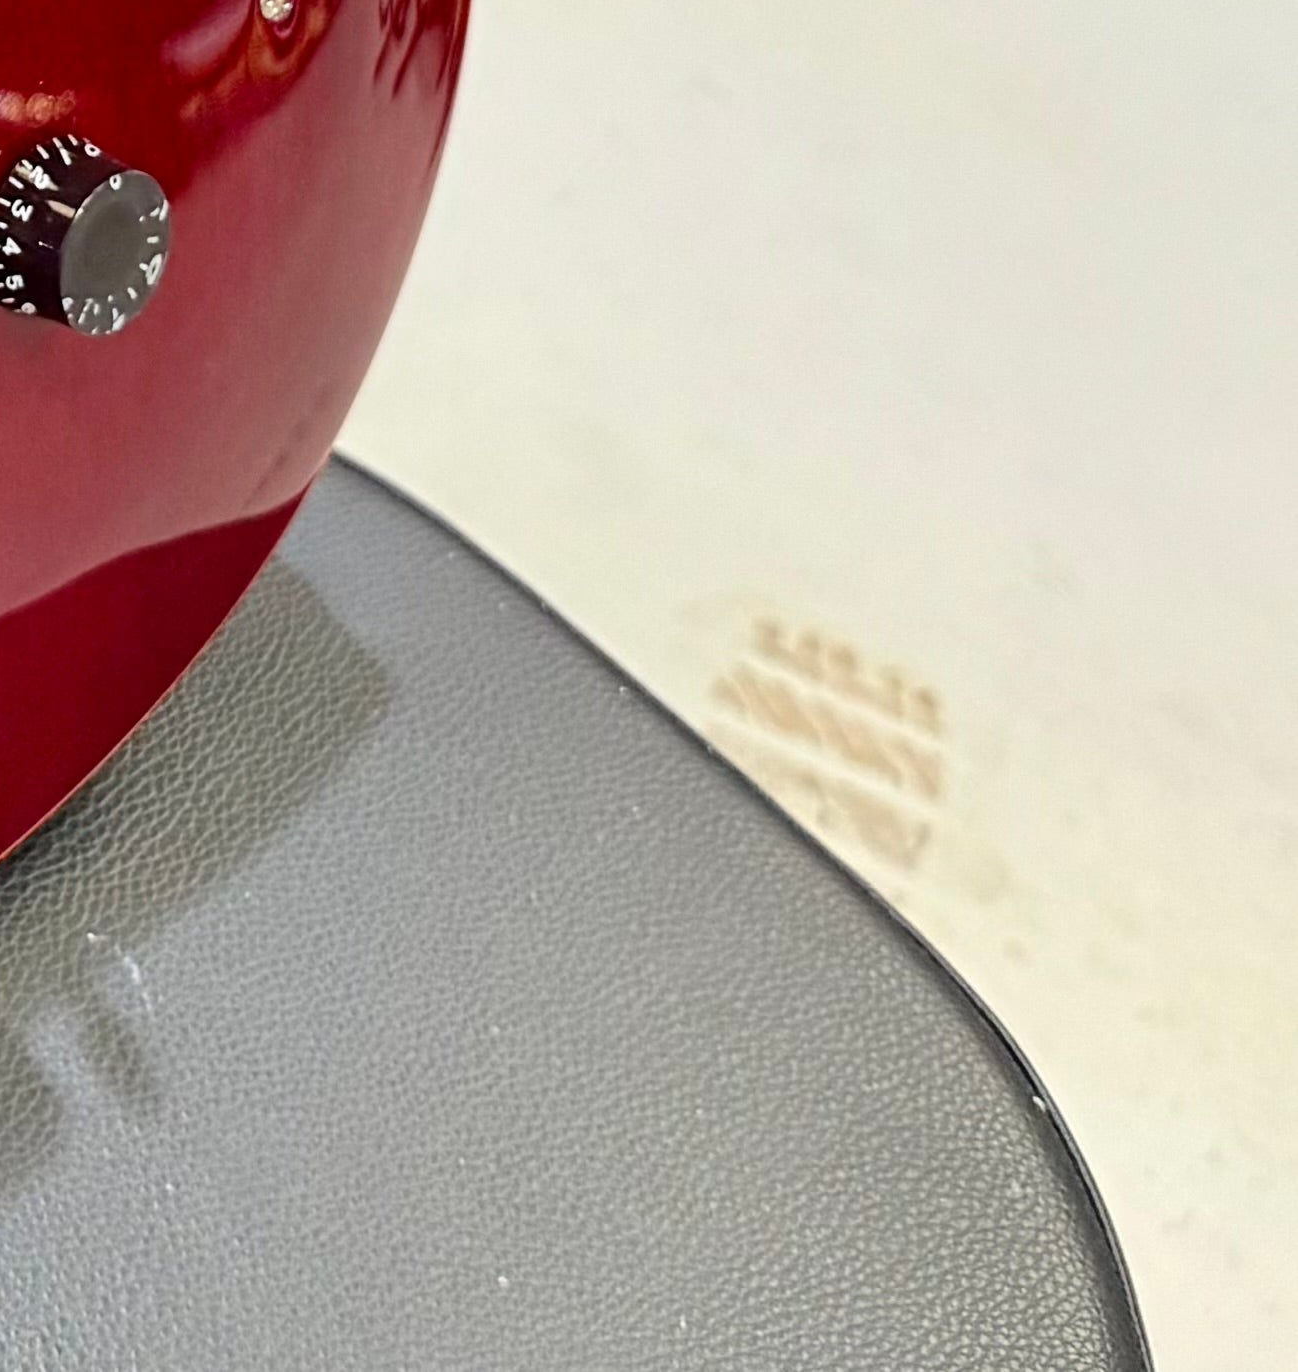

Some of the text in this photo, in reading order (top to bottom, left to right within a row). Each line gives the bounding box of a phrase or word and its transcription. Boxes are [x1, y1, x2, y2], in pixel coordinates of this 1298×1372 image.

[84, 142, 101, 158] 0
[29, 165, 53, 190] 2
[10, 198, 34, 222] 3
[2, 236, 23, 257] 4
[5, 273, 24, 291] 5
